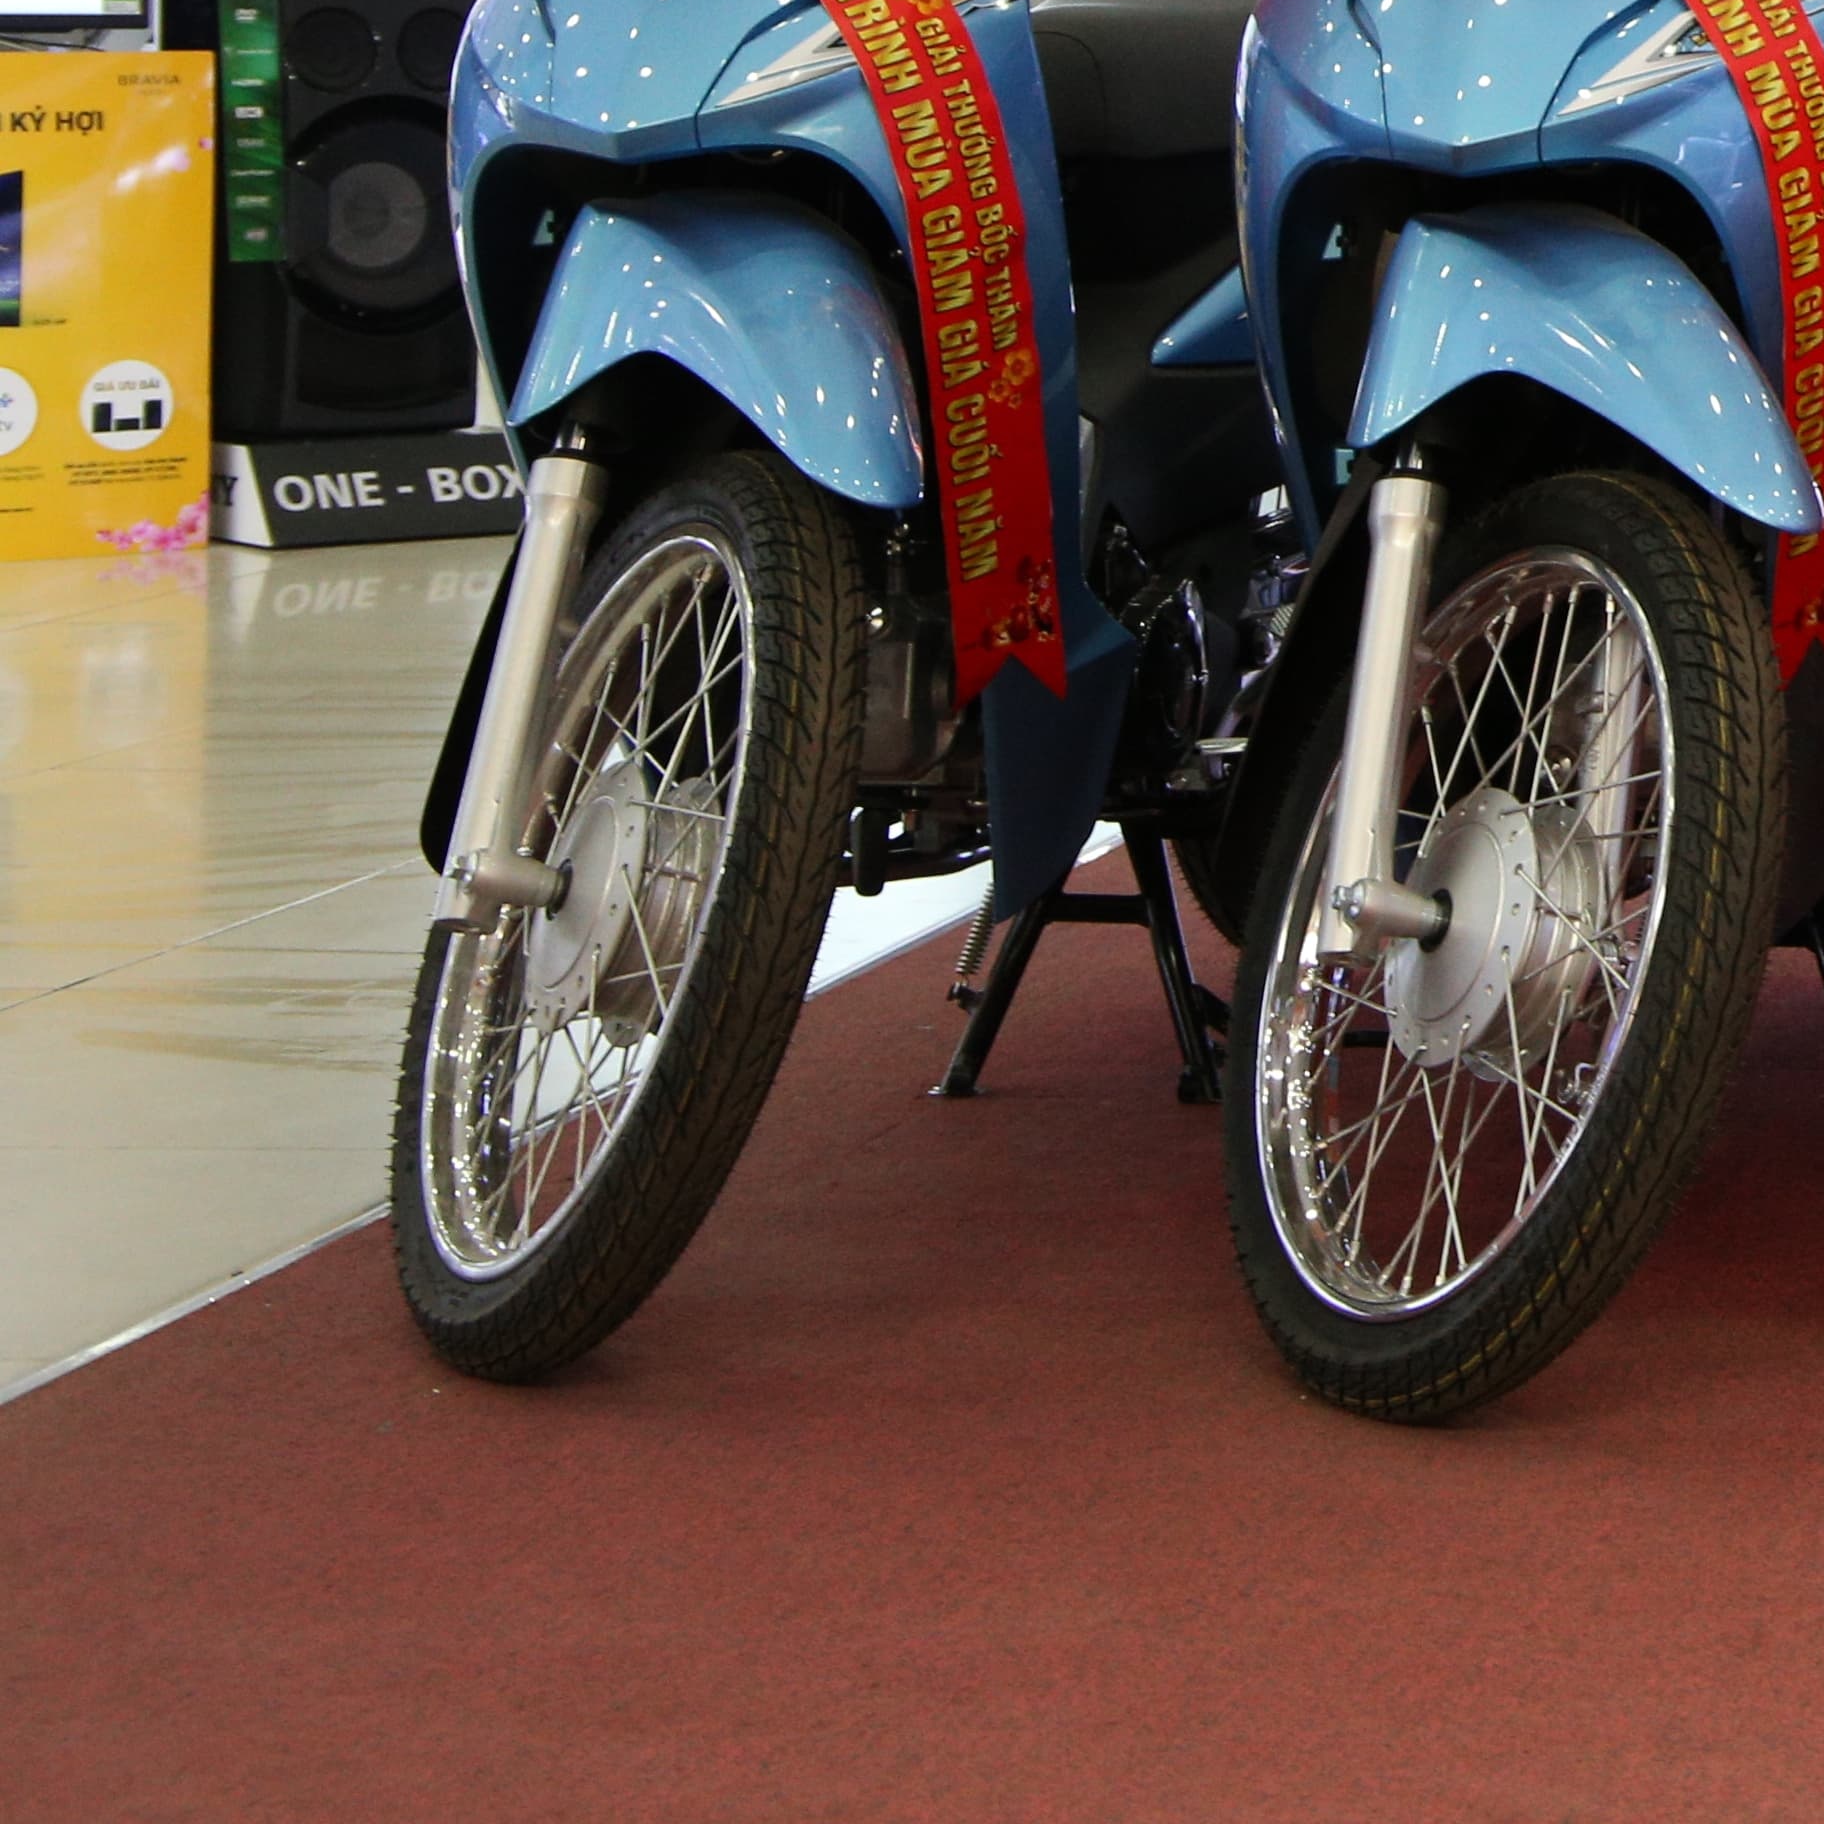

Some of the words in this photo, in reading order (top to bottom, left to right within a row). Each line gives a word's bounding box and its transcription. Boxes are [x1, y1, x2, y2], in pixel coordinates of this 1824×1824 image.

[117, 73, 181, 87] BRAVIA
[915, 17, 969, 79] GIẢI
[11, 104, 45, 132] KỶ
[55, 110, 105, 136] HỢI
[892, 97, 952, 200] MÙA
[942, 79, 999, 201] THƯỞNG
[976, 203, 1020, 264] BỐC
[1744, 60, 1803, 162] MÙA
[1793, 284, 1824, 360] GIÁ
[921, 204, 981, 314] GIẢM
[984, 270, 1025, 351] THĂM
[937, 318, 979, 389] GIÁ
[944, 393, 1004, 485] CUỐI
[273, 470, 385, 513] ONE
[430, 463, 529, 503] BOX
[953, 491, 1006, 582] NĂM
